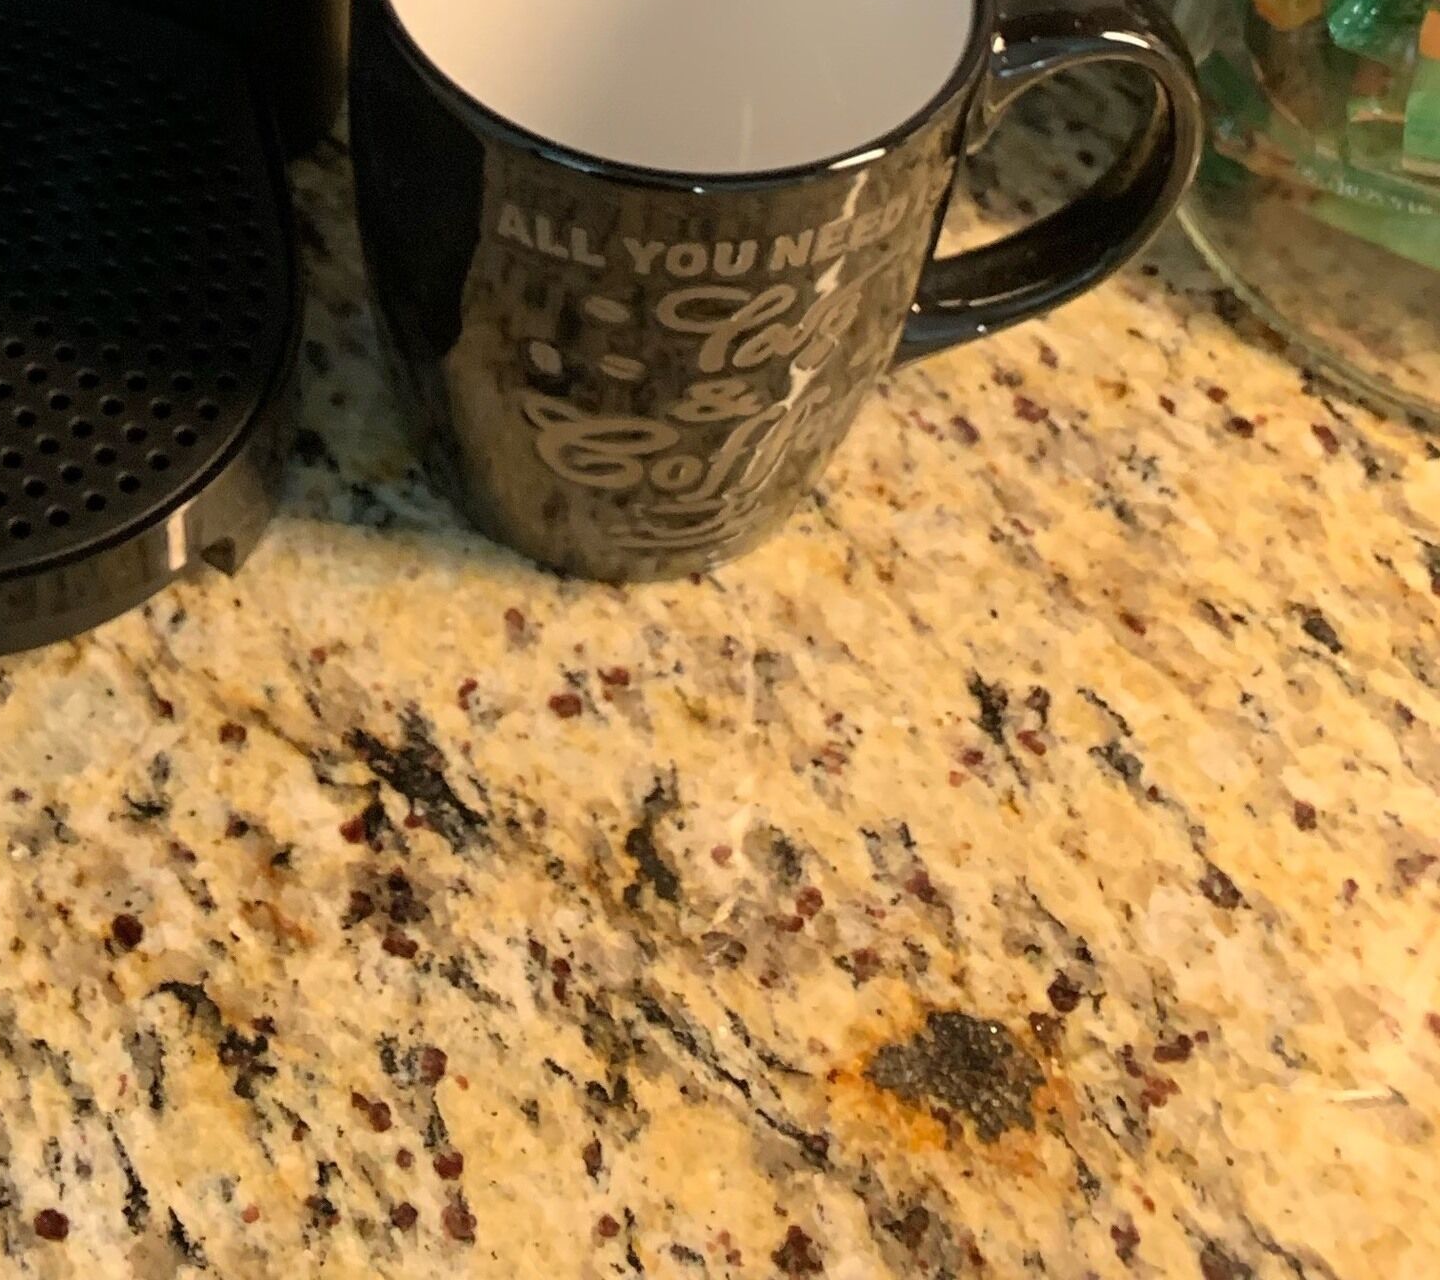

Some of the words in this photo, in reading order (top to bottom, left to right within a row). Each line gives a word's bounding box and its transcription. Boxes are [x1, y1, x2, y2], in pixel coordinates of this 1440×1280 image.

[497, 204, 605, 269] ALL
[624, 240, 758, 278] YOU
[665, 376, 766, 423] &
[521, 384, 840, 504] Coffe
